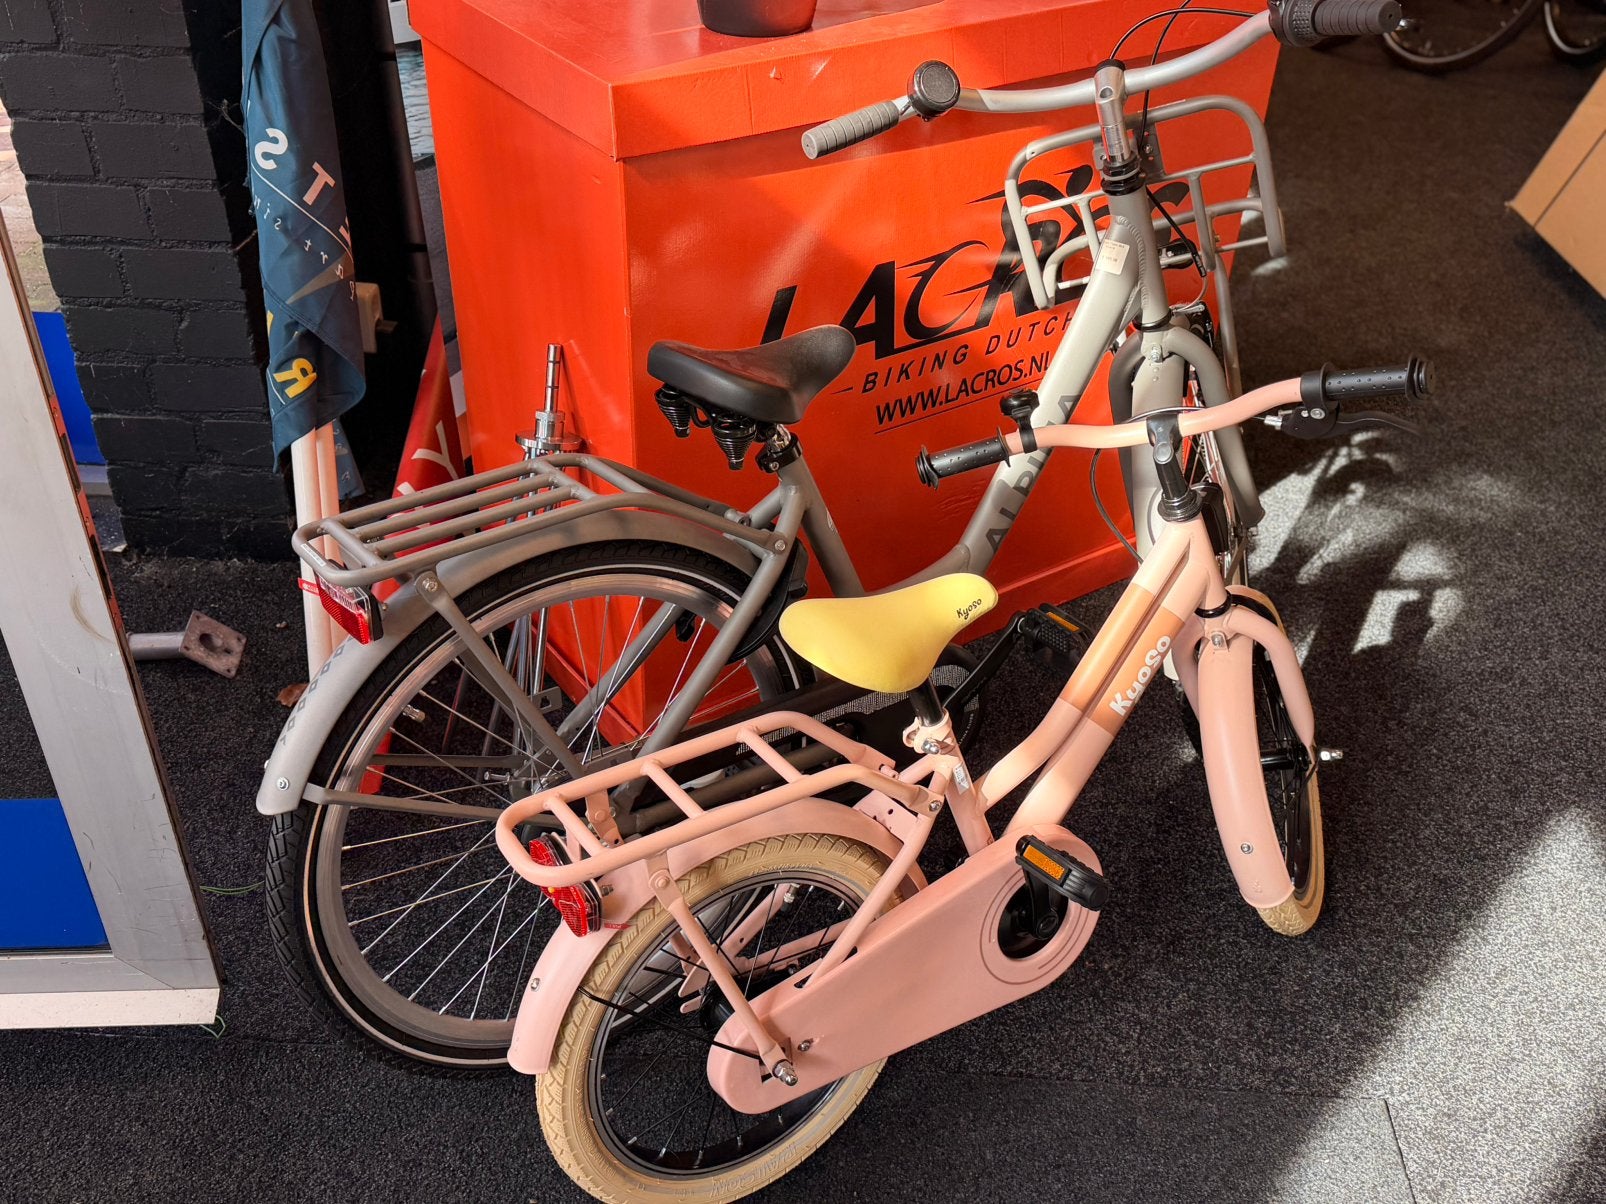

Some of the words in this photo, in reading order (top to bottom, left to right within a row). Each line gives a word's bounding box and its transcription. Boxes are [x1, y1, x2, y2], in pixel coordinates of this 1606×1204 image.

[862, 343, 969, 394] BIKING
[985, 311, 1073, 356] DUTCH
[875, 350, 1052, 426] WWW.LACROS.NL
[956, 598, 982, 620] Kyoso
[1109, 635, 1171, 717] Kyoso
